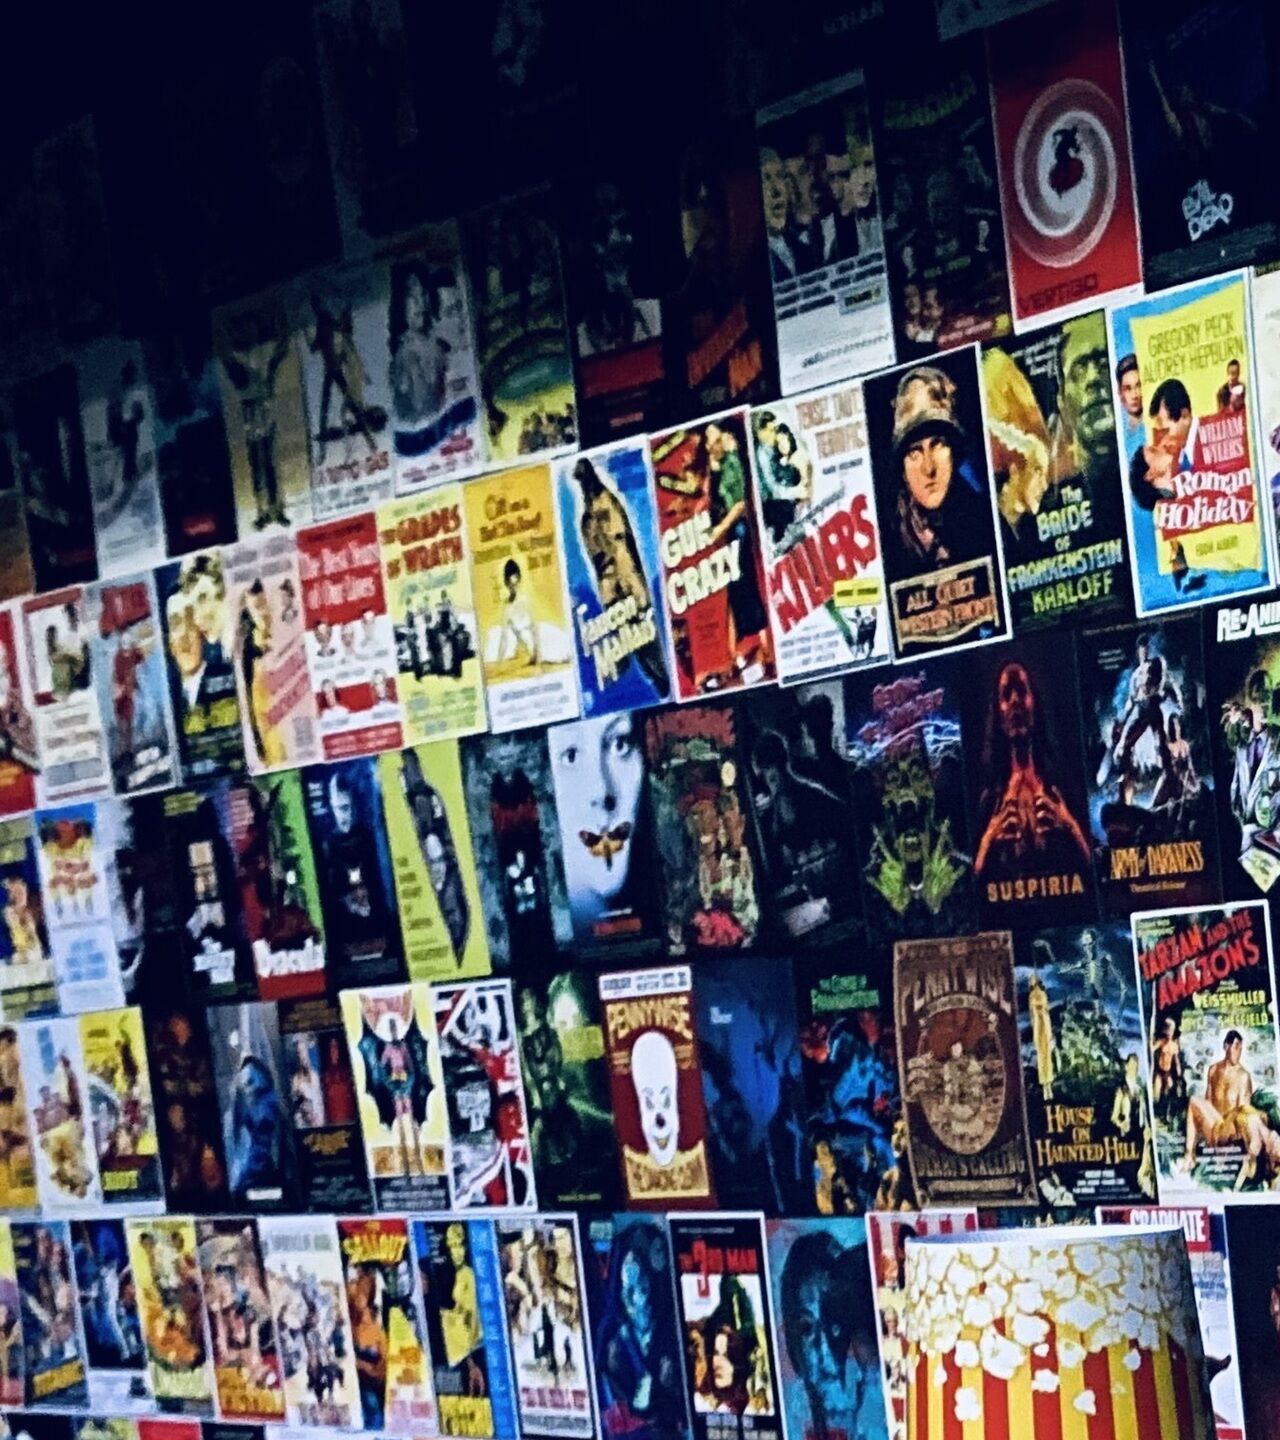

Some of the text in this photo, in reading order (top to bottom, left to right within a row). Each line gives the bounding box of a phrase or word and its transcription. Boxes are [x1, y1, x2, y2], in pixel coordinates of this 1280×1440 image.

[1148, 311, 1234, 358] GREGORY PECK
[1143, 335, 1244, 384] AUDREY HEPBURN
[1171, 467, 1254, 499] Roman
[1036, 500, 1093, 542] BRIDE
[1157, 494, 1256, 530] Holiday
[666, 539, 743, 615] CRAZY
[1007, 537, 1123, 593] FRANKENSTEIN
[1031, 569, 1113, 613] KARLOFF
[988, 873, 1085, 903] SUSPIRIA
[1138, 924, 1204, 982] TARZAN
[1157, 930, 1262, 1012] AMAZONS
[1046, 1103, 1095, 1134] HOUSE
[1072, 1126, 1090, 1144] ON
[1035, 1136, 1141, 1167] HAUNTED HILL
